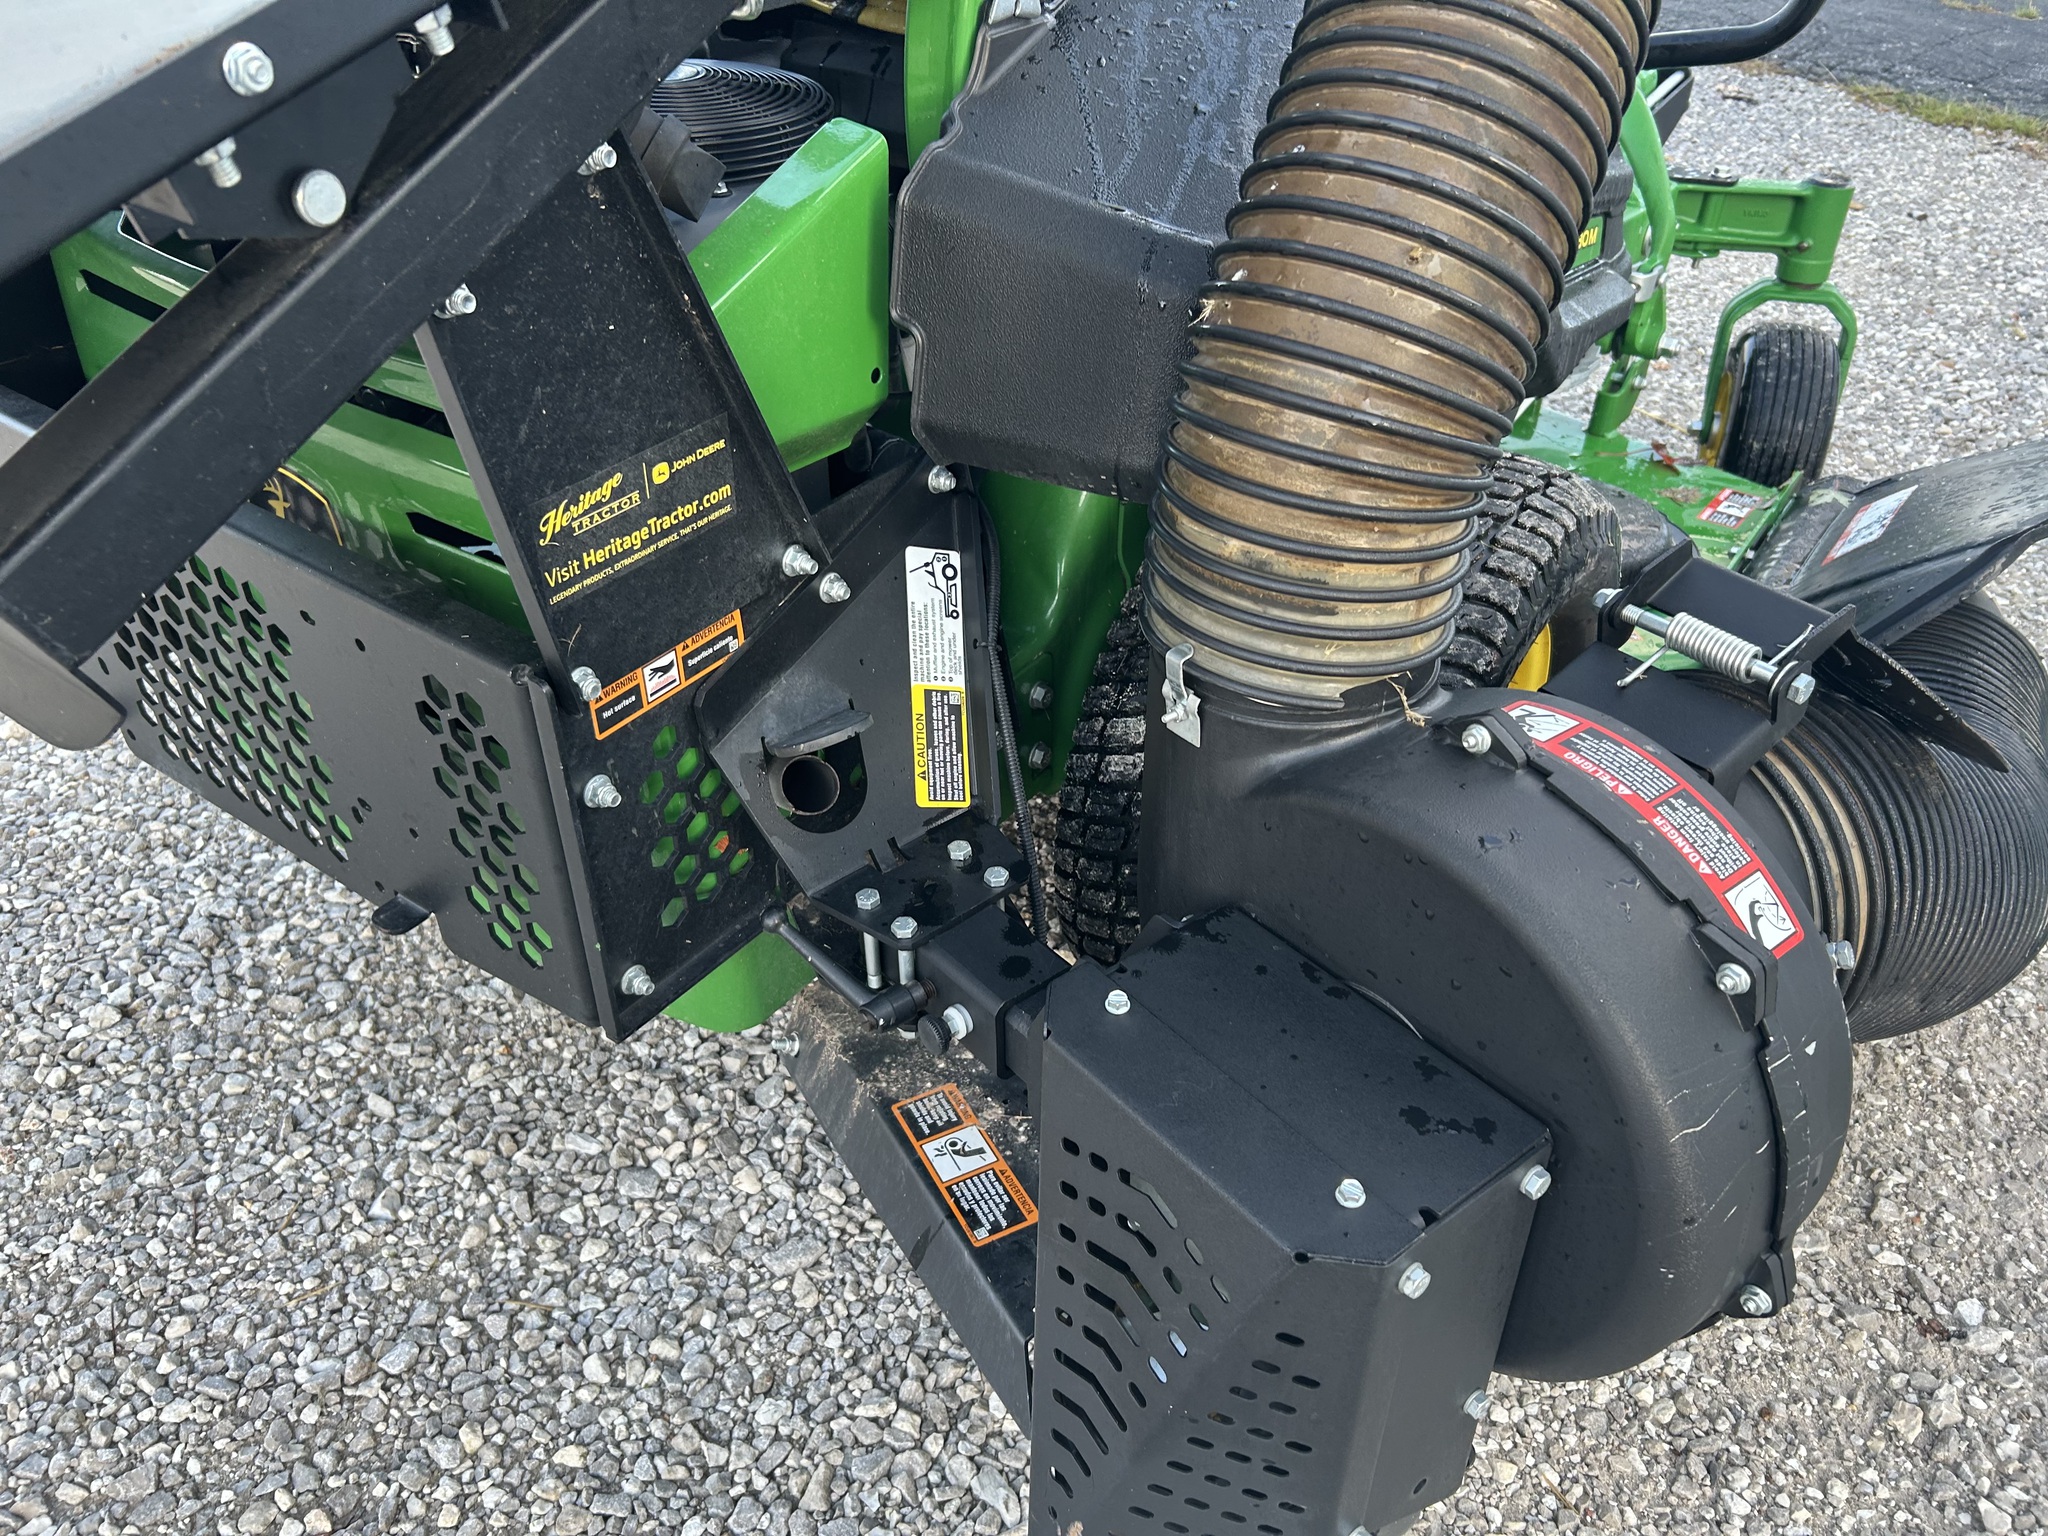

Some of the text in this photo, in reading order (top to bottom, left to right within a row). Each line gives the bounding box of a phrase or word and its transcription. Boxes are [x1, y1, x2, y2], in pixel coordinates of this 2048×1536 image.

[671, 439, 726, 472] JOHN DEERE
[539, 472, 623, 546] Heritage
[572, 492, 641, 533] TRACTOR
[544, 484, 732, 588] Visit HeritageTractor.com
[550, 582, 582, 605] LEGENDARY
[614, 544, 657, 571] EXTRAORDINARY
[697, 516, 709, 528] OUR
[691, 614, 735, 646] ADVERTENCIA
[603, 672, 638, 699] WARNING
[602, 695, 636, 719] Hot surface
[916, 713, 926, 768] CAUTION
[1564, 751, 1620, 790] PELIGRO
[1652, 815, 1702, 864] DANGER
[1693, 842, 1710, 861] injury
[1709, 861, 1725, 878] Avoid
[1004, 1174, 1033, 1215] ADVERTENCIA
